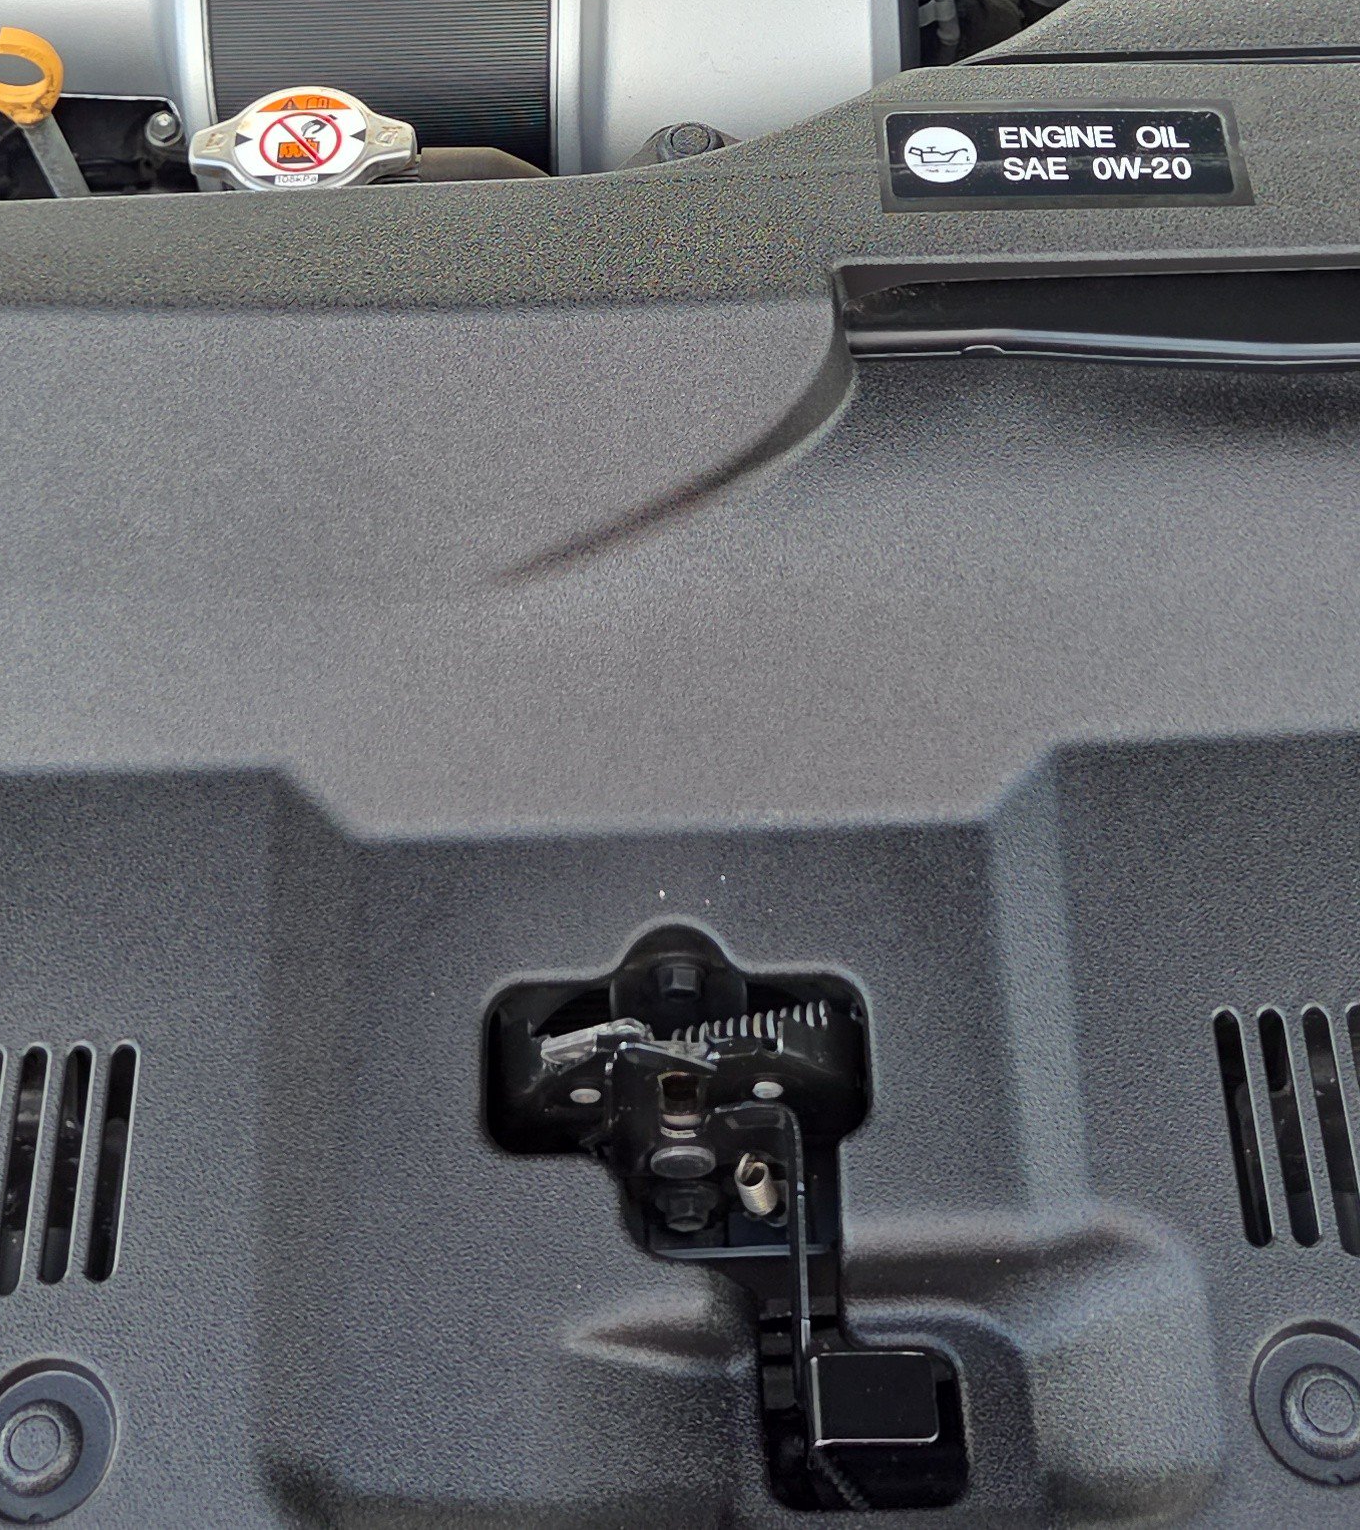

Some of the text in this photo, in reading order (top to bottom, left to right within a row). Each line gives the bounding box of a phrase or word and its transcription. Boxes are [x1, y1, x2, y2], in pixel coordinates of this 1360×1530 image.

[999, 126, 1190, 150] ENGINE OIL
[1003, 155, 1193, 182] SAE 0W-20
